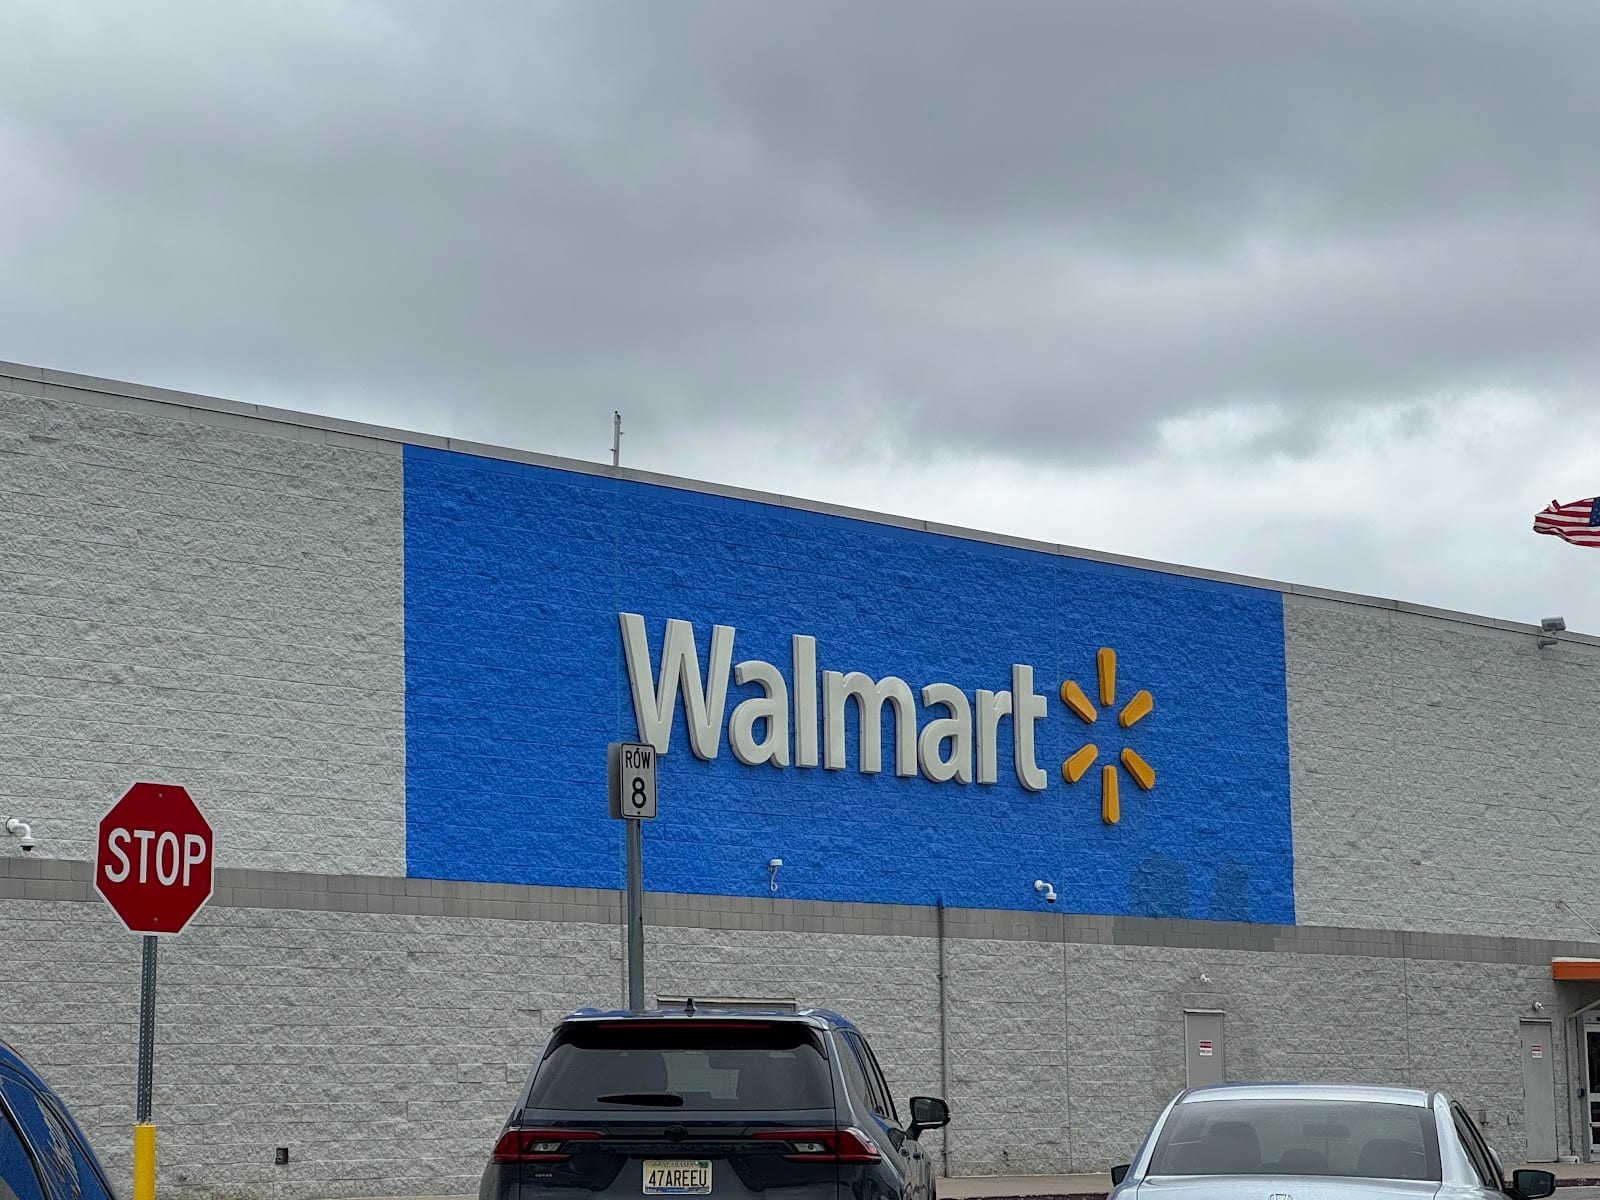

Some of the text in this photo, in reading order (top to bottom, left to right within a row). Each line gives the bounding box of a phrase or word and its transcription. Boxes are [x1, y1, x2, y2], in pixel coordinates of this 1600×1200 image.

[619, 612, 1047, 791] Walmart
[625, 750, 651, 769] ROW
[631, 776, 647, 808] 8
[104, 827, 207, 887] STOP
[648, 1170, 707, 1187] 47AREEU
